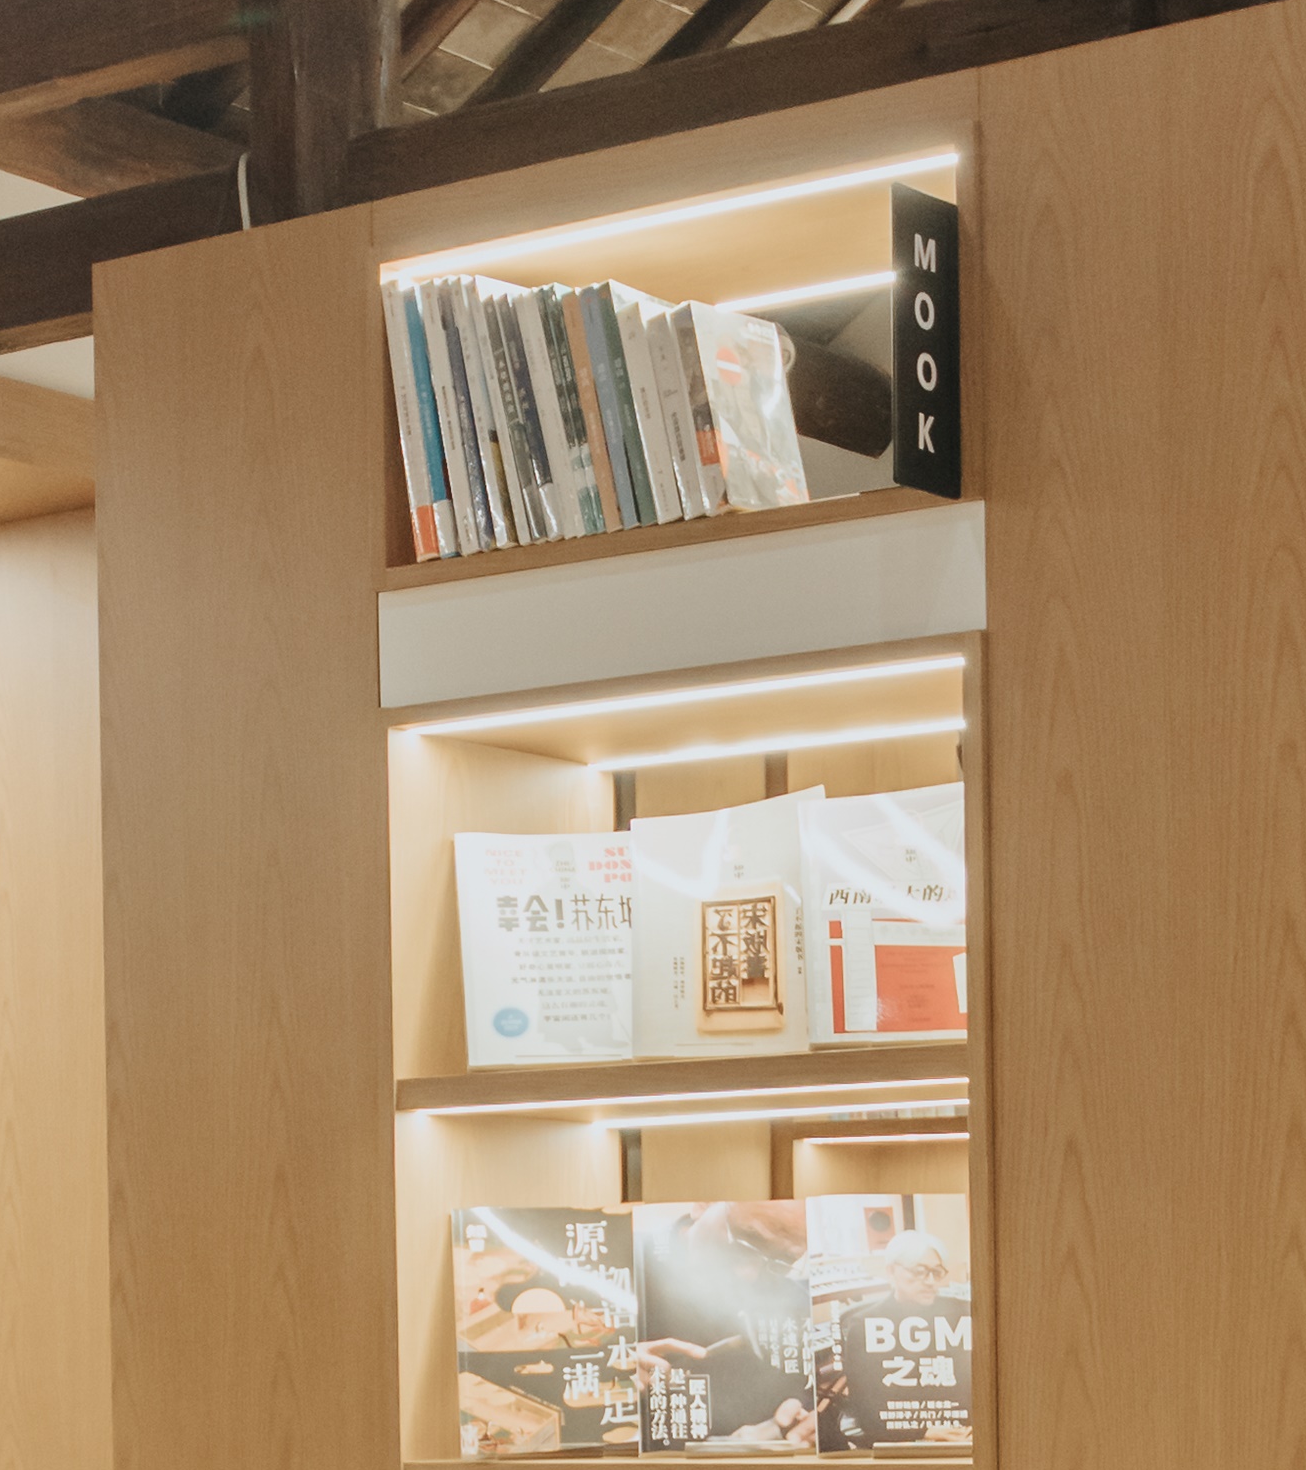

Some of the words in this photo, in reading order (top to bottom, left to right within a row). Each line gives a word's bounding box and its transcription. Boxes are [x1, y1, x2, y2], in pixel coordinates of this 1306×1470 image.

[913, 232, 938, 454] MOOK
[589, 859, 632, 871] DON
[864, 1315, 973, 1353] BGM
[882, 1355, 958, 1388] 之魂
